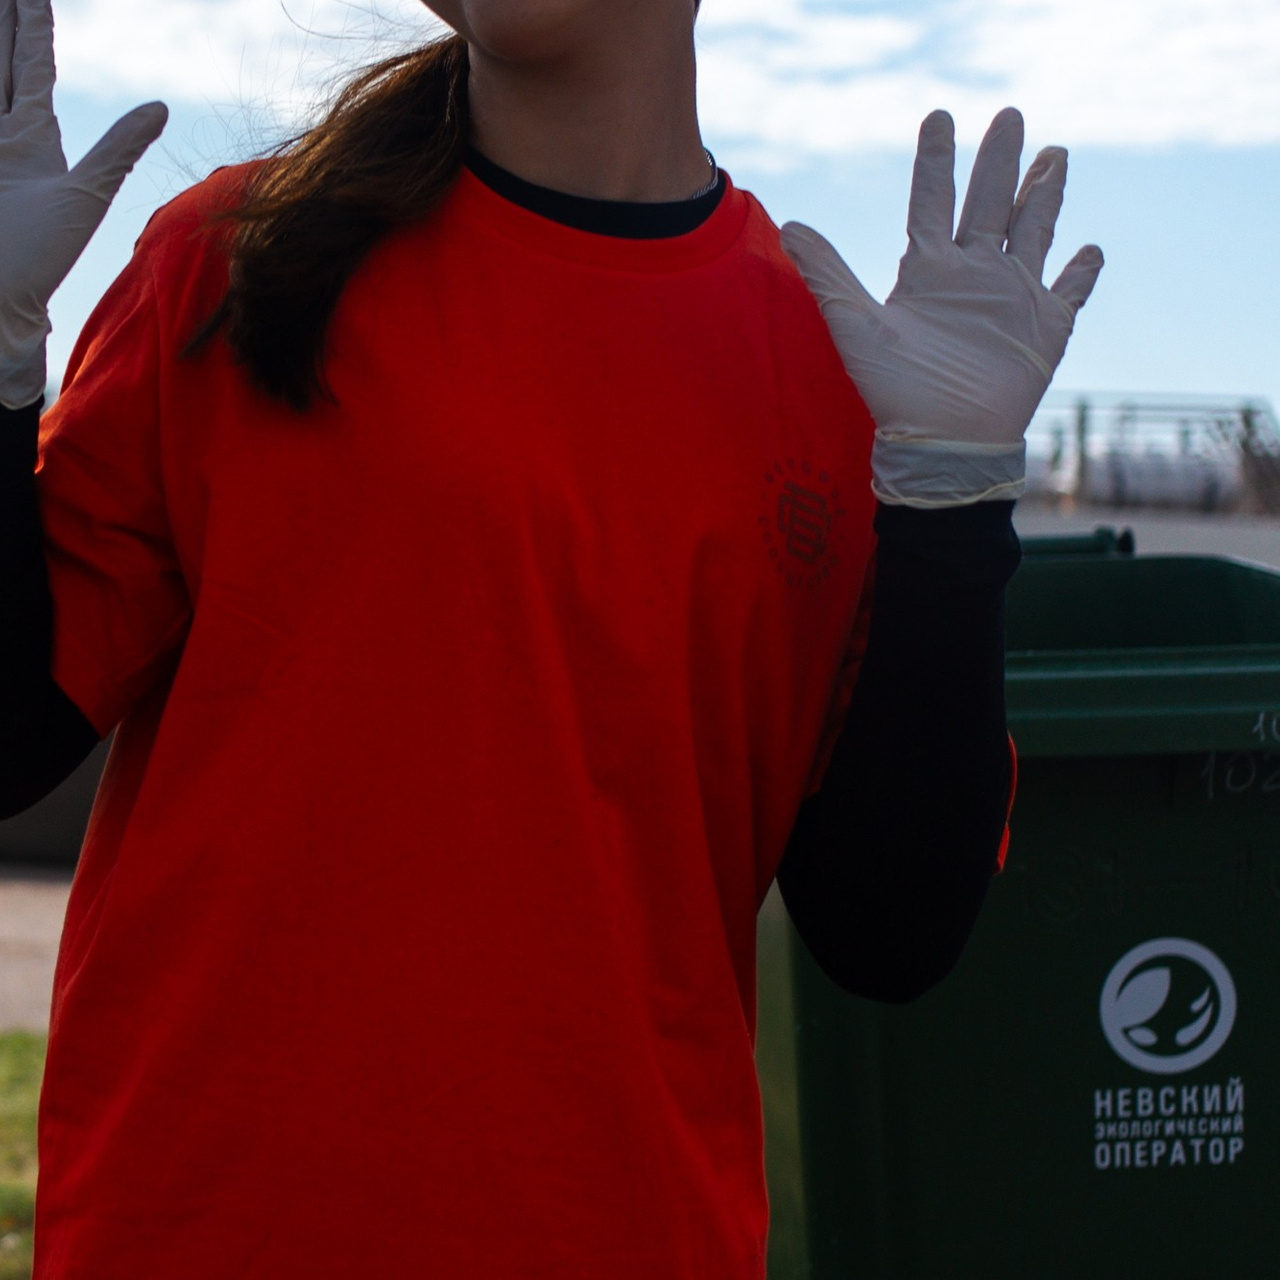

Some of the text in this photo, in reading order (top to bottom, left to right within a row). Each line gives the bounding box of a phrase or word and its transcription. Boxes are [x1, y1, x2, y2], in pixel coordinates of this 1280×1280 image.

[1094, 1077, 1245, 1119] НЕВСКИЙ
[1095, 1114, 1244, 1140] ЭКОЛОГИЧЕСКИЙ
[1094, 1137, 1245, 1169] ОПЕРАТОР
